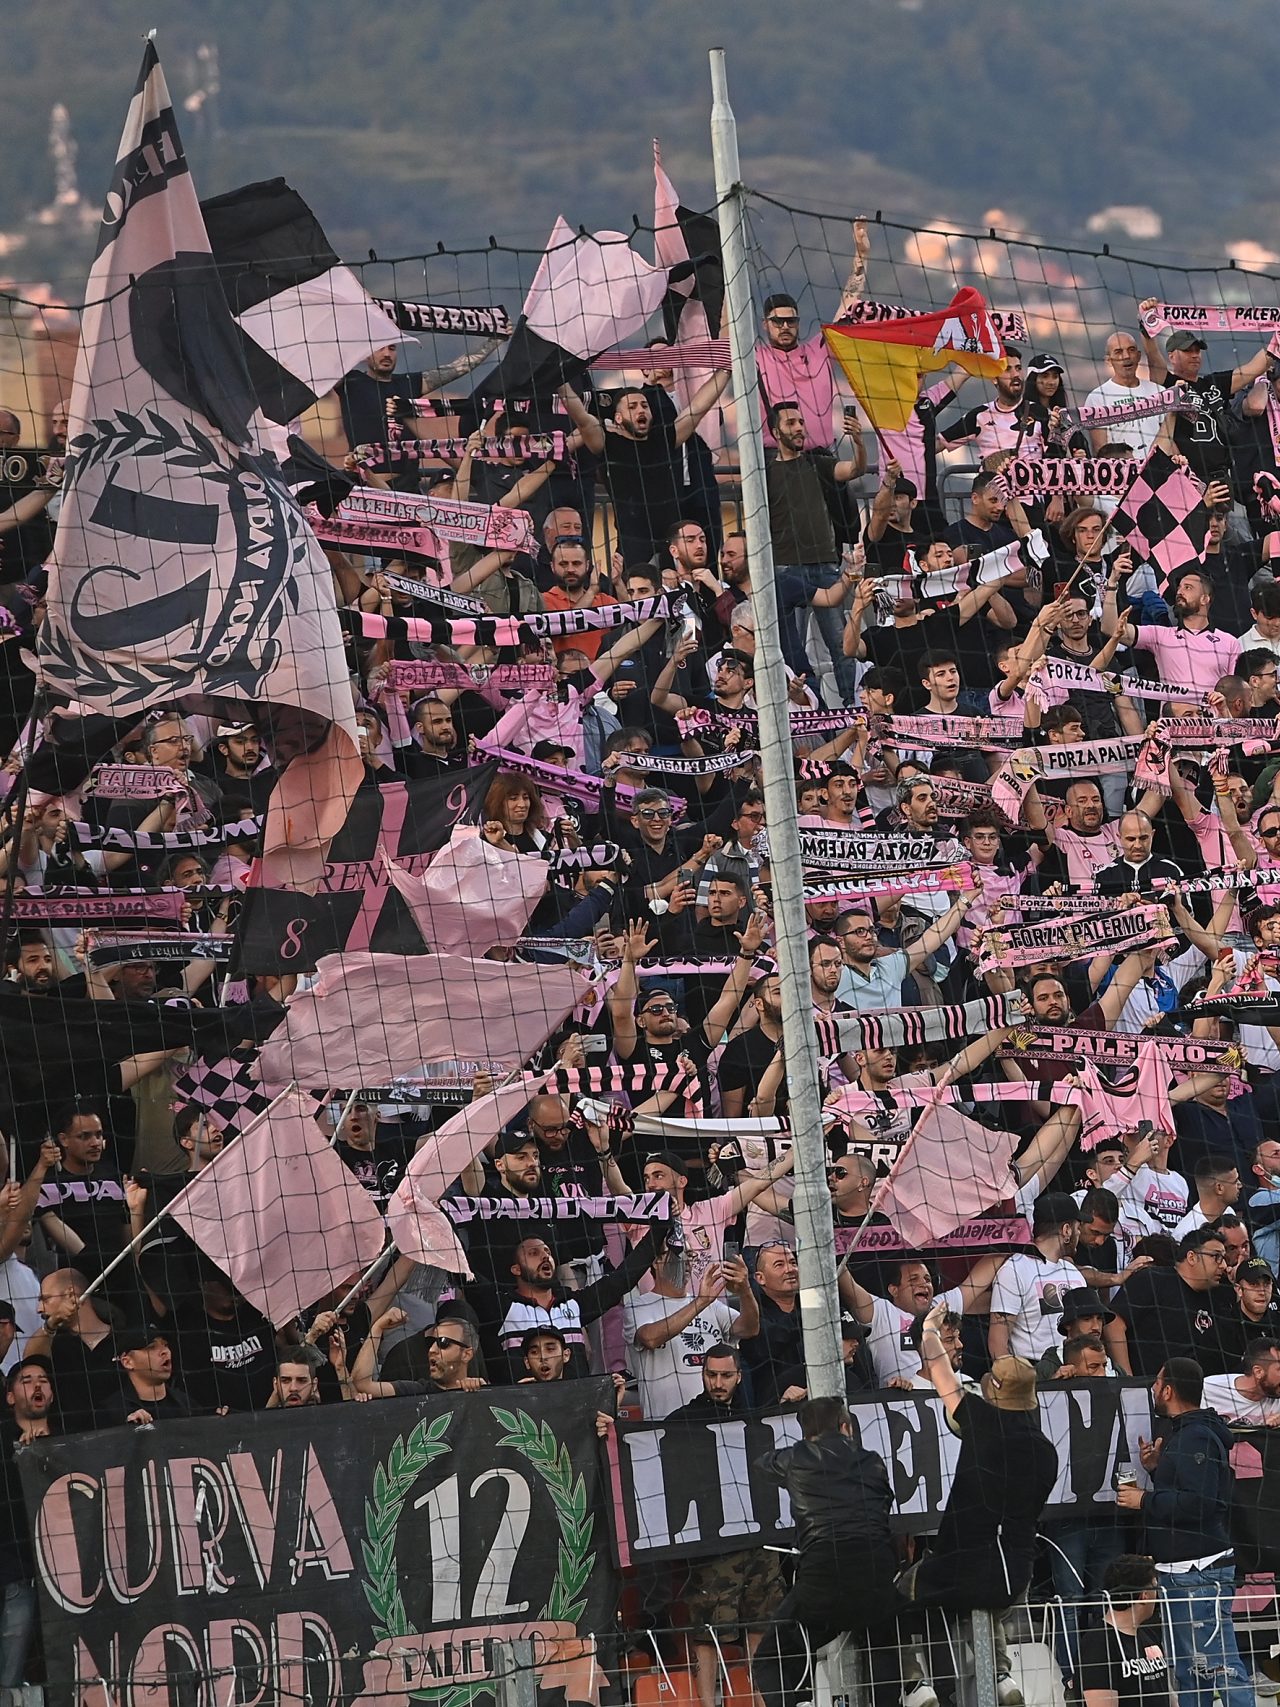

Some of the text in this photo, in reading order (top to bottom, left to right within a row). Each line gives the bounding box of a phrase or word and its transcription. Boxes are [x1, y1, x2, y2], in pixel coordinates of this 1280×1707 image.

[403, 303, 510, 335] TERRONE
[1163, 306, 1208, 320] FORZA
[1078, 389, 1176, 422] PALERMO
[395, 663, 554, 686] FORZA PALERM
[1047, 663, 1094, 682] FORZA
[1049, 741, 1141, 770] FORZA PALER
[99, 770, 181, 787] PALERM
[72, 814, 264, 850] PALERM
[1187, 873, 1255, 893] FORZA
[1019, 900, 1101, 909] FORZA PALERMO
[280, 918, 308, 959] 8
[1009, 912, 1148, 951] FORZA PALERMO
[1051, 1034, 1207, 1064] PALEMO
[425, 1089, 466, 1104] caput
[35, 1442, 355, 1614] CURVA
[414, 1467, 530, 1623] 12
